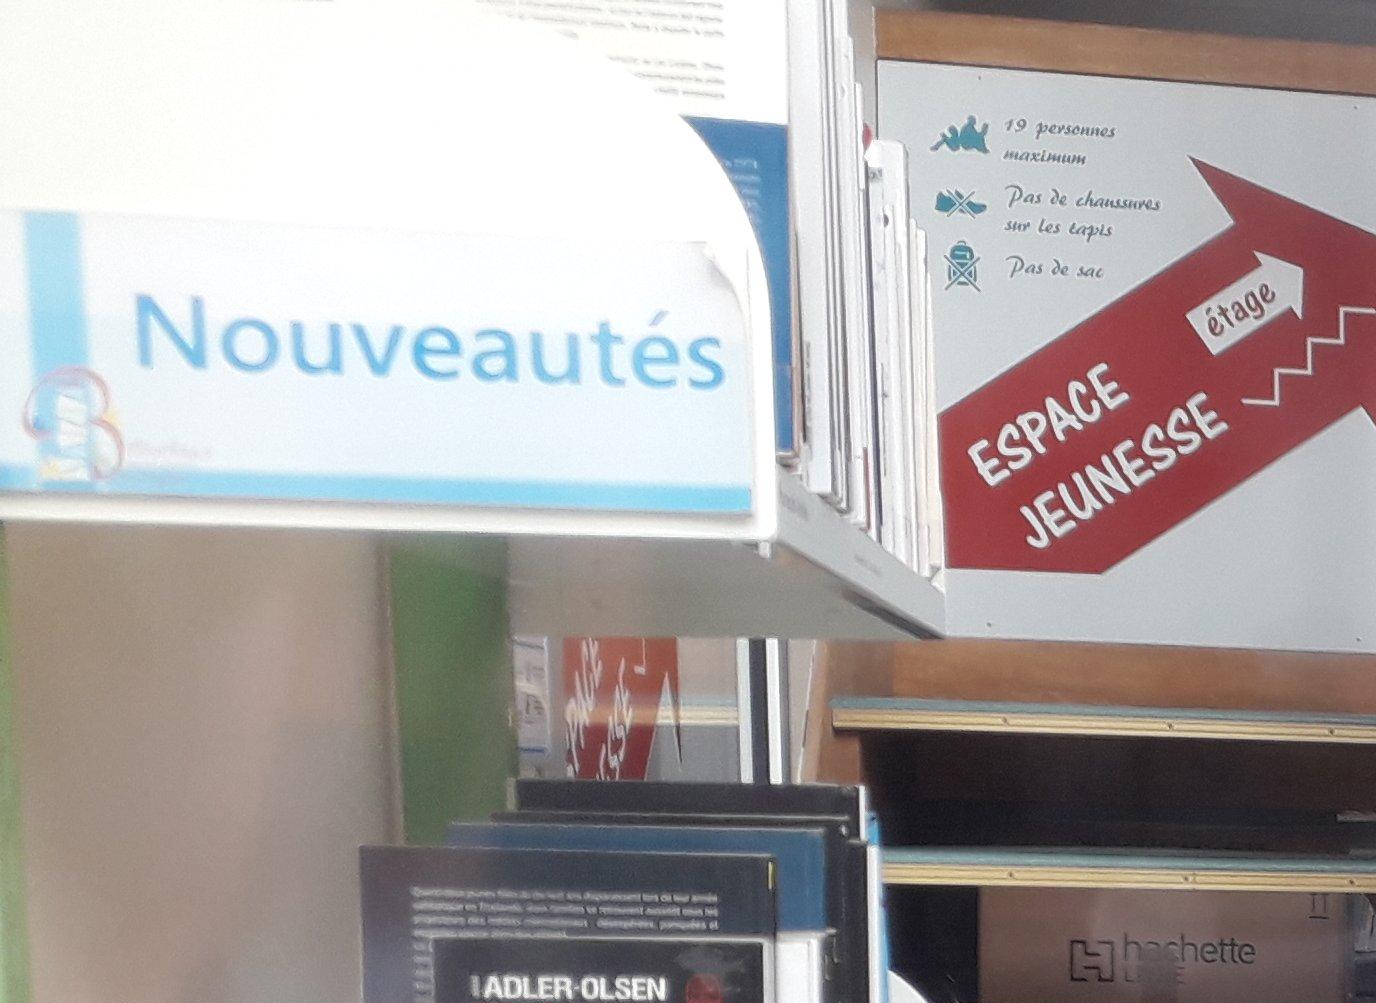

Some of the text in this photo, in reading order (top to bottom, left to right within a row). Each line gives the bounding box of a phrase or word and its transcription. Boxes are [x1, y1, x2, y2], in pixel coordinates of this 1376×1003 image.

[1005, 118, 1117, 140] 19 personnes
[1003, 150, 1087, 165] maximum
[1004, 184, 1161, 211] Pas de chaussures
[1004, 218, 1113, 243] sur les tapis
[1005, 255, 1104, 278] Pas de sac
[1206, 280, 1277, 339] étage
[134, 293, 727, 391] Nouveautés
[966, 362, 1131, 488] ESPACE
[1019, 391, 1230, 550] JEUNESSE
[1124, 933, 1256, 965] hachette
[484, 973, 668, 1002] ADLER-OLSEN
